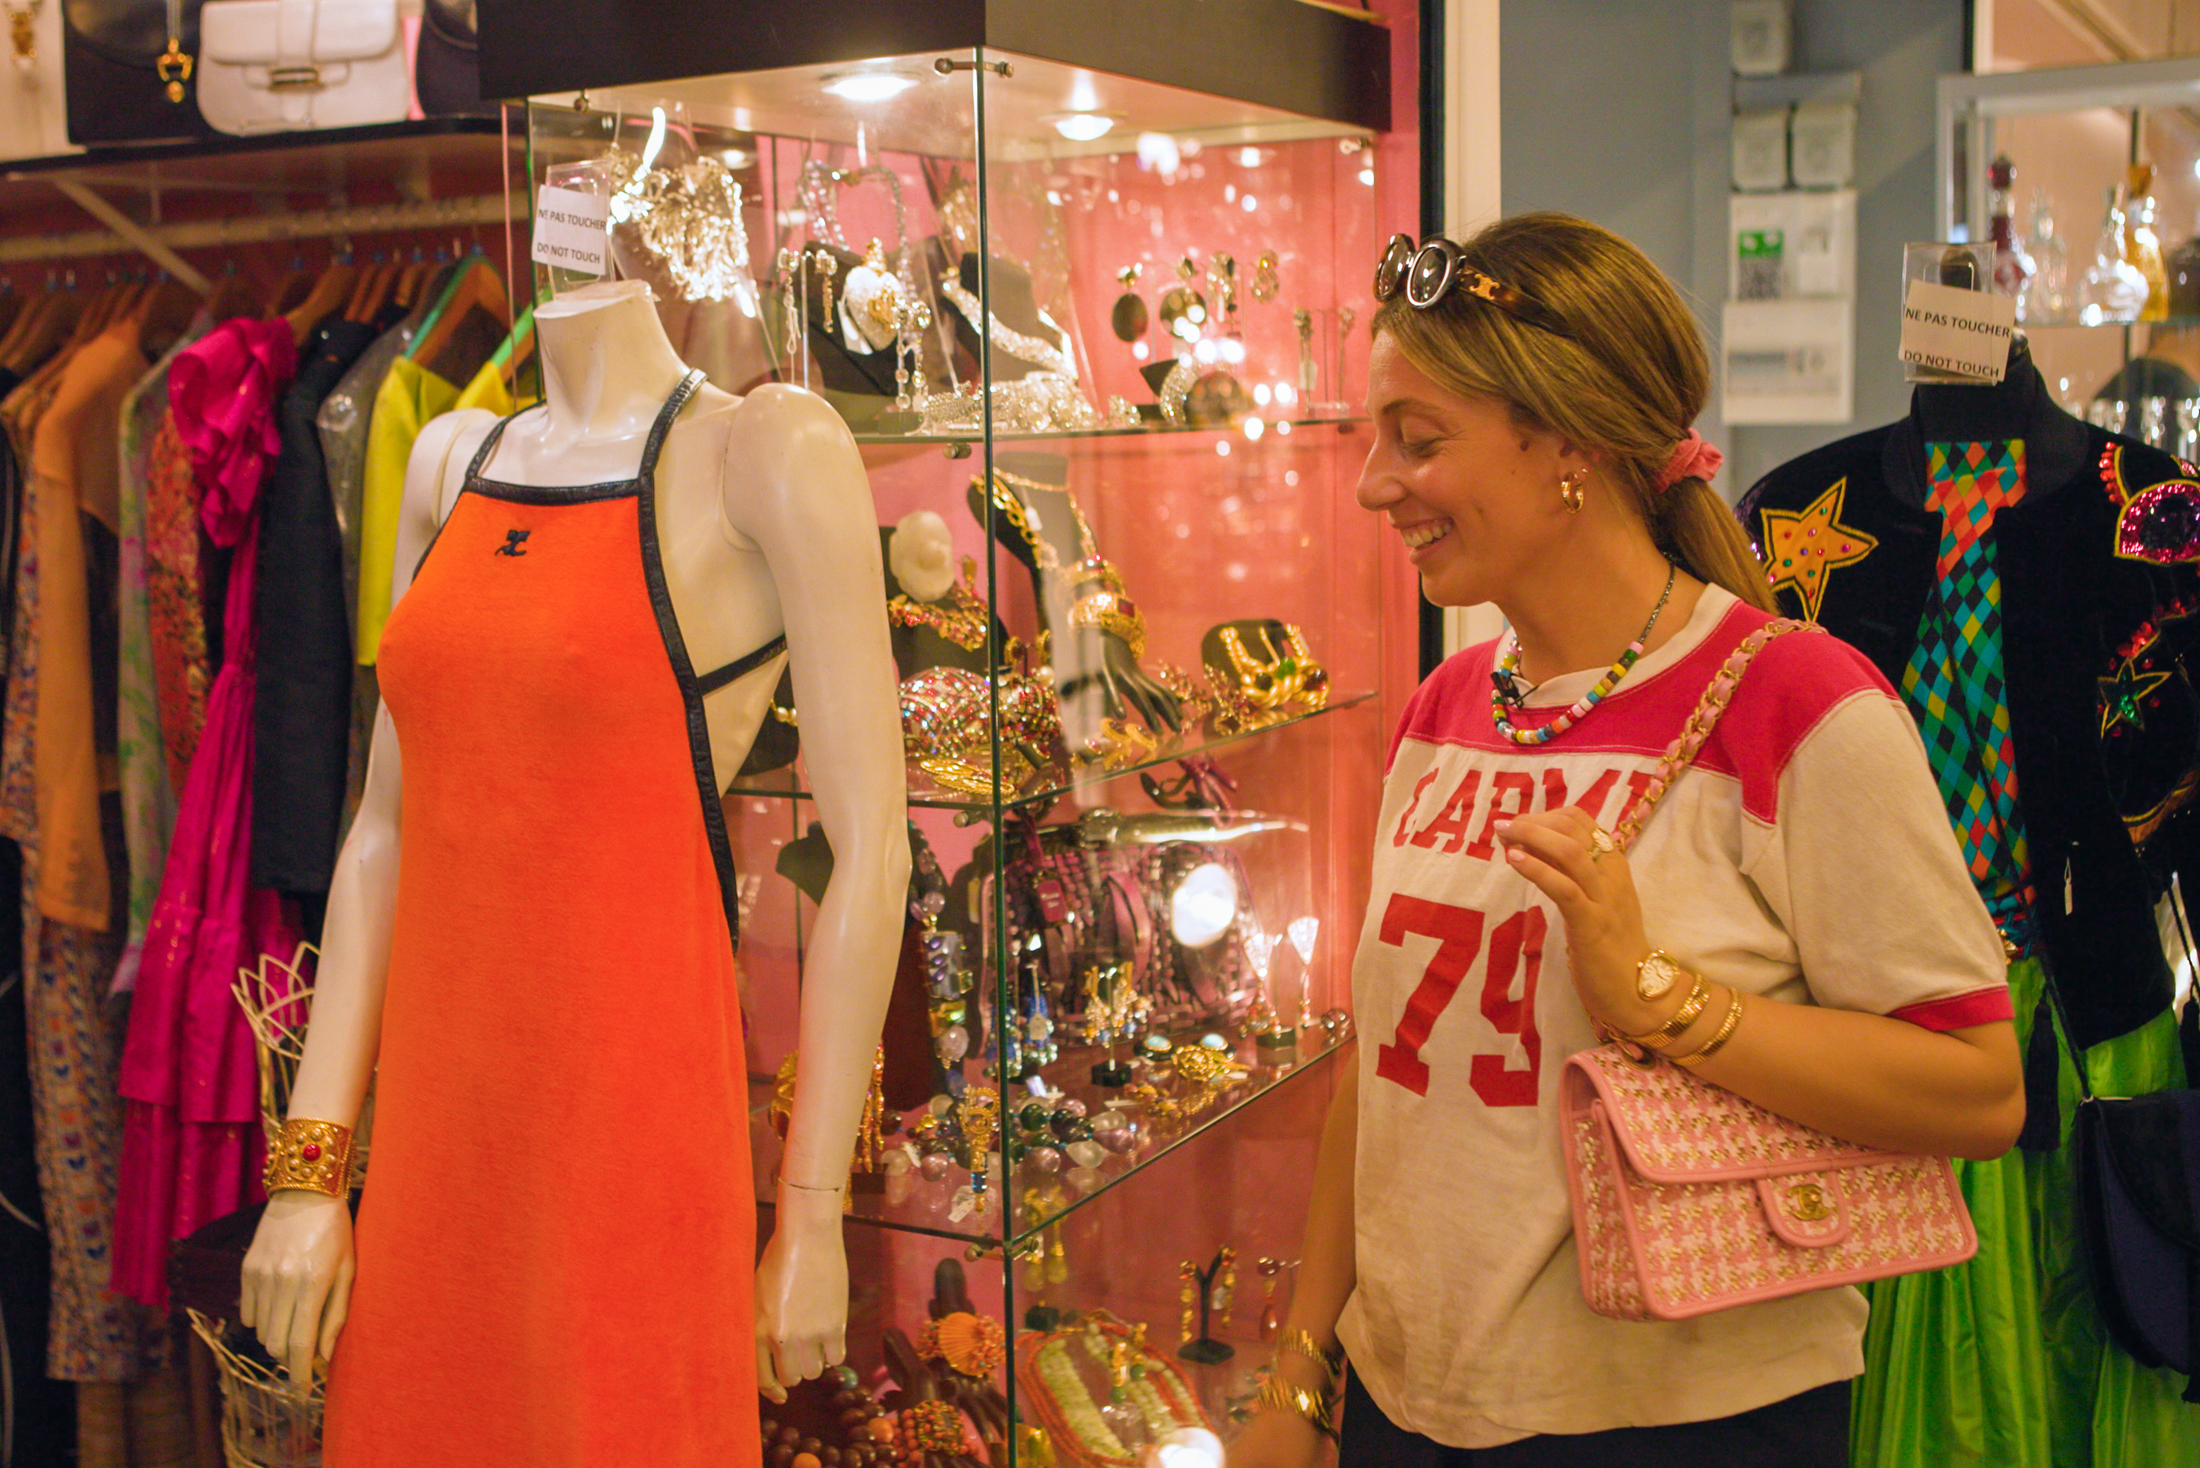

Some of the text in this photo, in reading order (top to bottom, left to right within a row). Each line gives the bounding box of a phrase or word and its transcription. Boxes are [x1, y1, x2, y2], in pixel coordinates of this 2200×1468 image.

[537, 208, 607, 231] NE PAS TOUCHER
[537, 242, 601, 264] DO NOT TOUCH
[1905, 307, 2011, 338] NE PAS TOUCHER
[1904, 350, 2000, 378] DO NOT TOUCH
[1375, 892, 1548, 1107] 79
